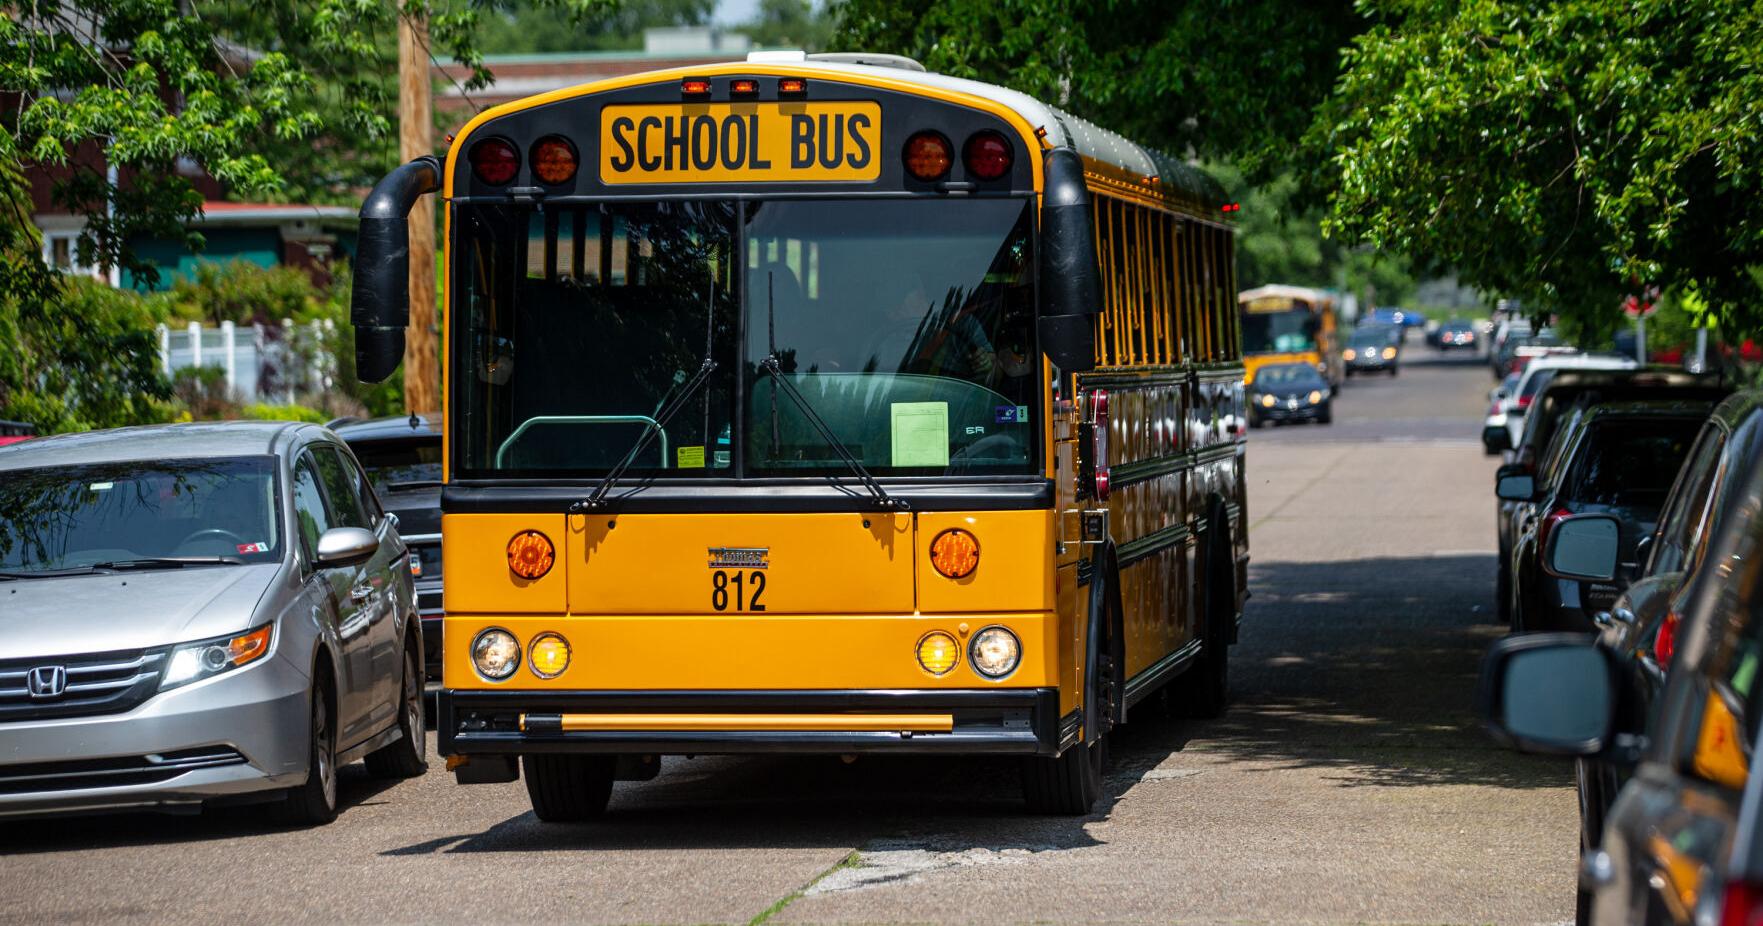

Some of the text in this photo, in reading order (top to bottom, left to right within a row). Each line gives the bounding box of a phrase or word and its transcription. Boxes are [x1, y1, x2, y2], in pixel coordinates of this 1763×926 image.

[610, 113, 871, 172] SCHOOL BUS
[712, 570, 766, 611] 812
